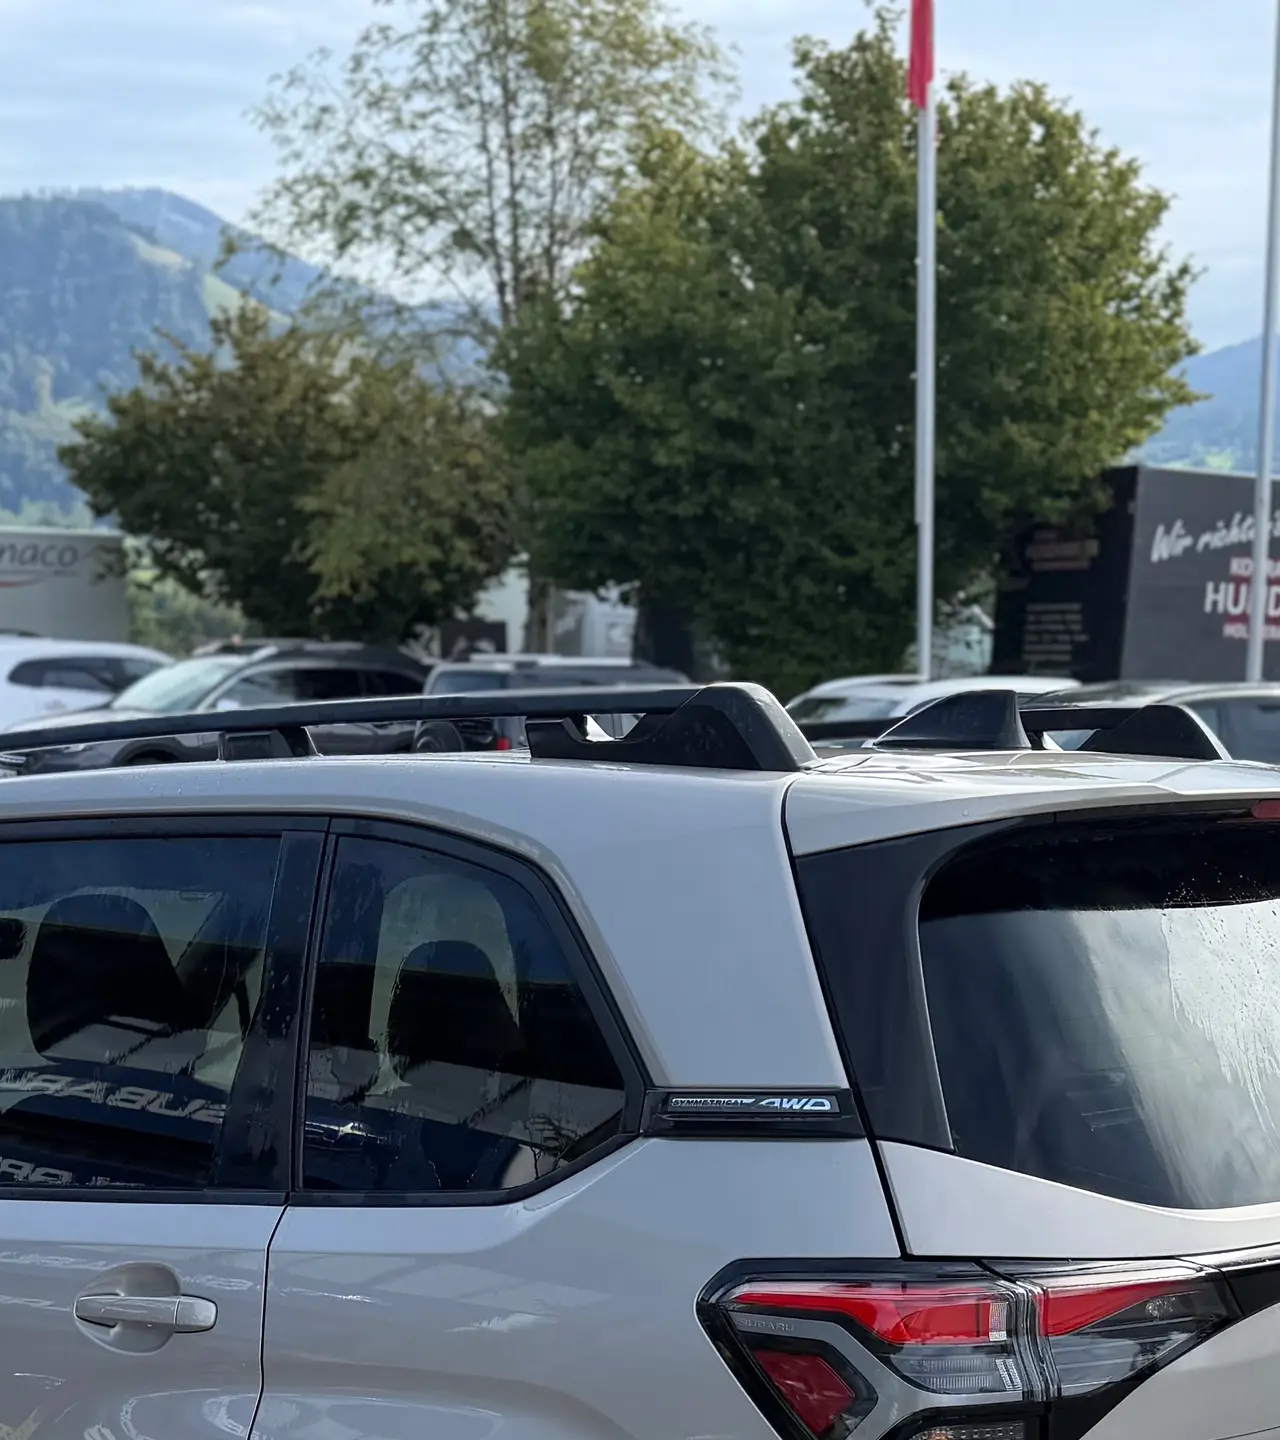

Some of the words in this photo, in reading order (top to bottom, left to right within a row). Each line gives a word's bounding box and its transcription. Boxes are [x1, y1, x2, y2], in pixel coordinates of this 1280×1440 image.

[1151, 518, 1193, 562] Wir
[671, 1097, 745, 1108] SYMMETRICAL
[756, 1097, 832, 1111] AWD
